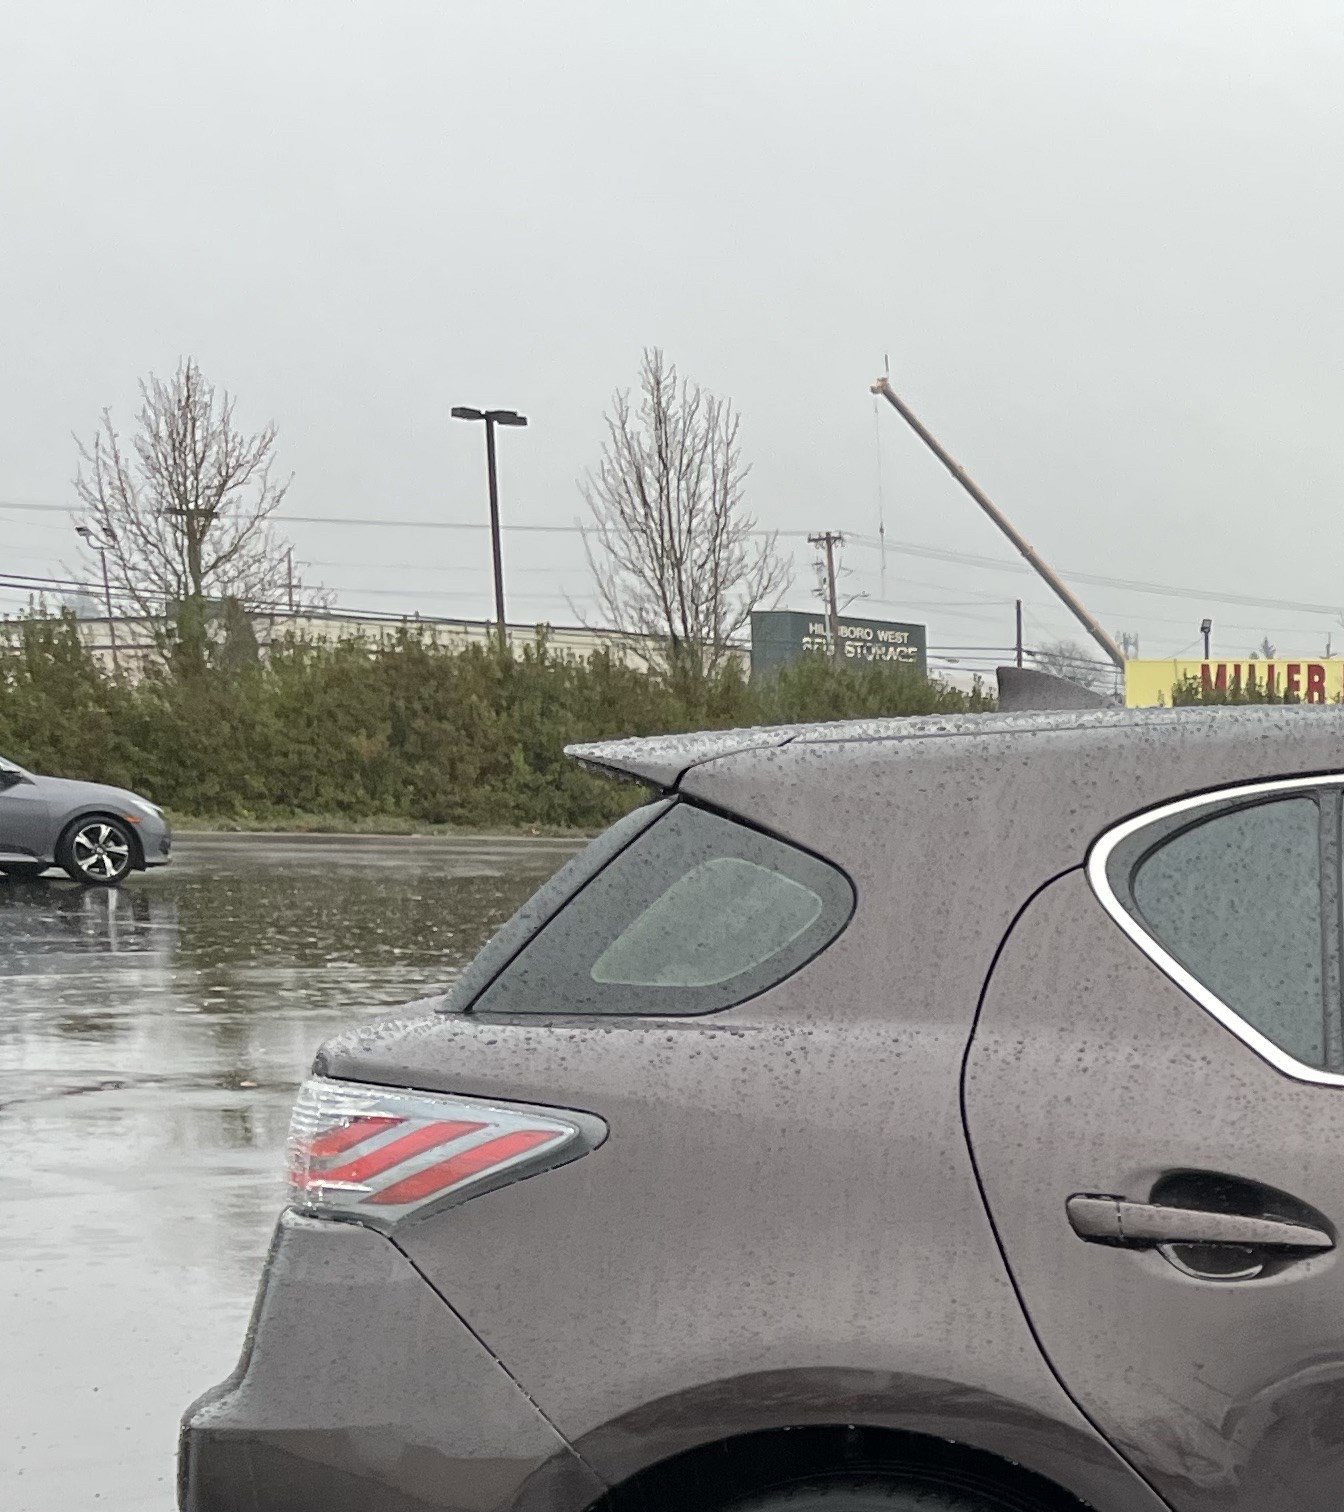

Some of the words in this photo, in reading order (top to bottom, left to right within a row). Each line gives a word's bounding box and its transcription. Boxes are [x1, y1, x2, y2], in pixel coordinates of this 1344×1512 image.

[808, 622, 874, 641] HILBORO
[877, 629, 910, 644] WEST
[1201, 663, 1326, 704] MILLER
